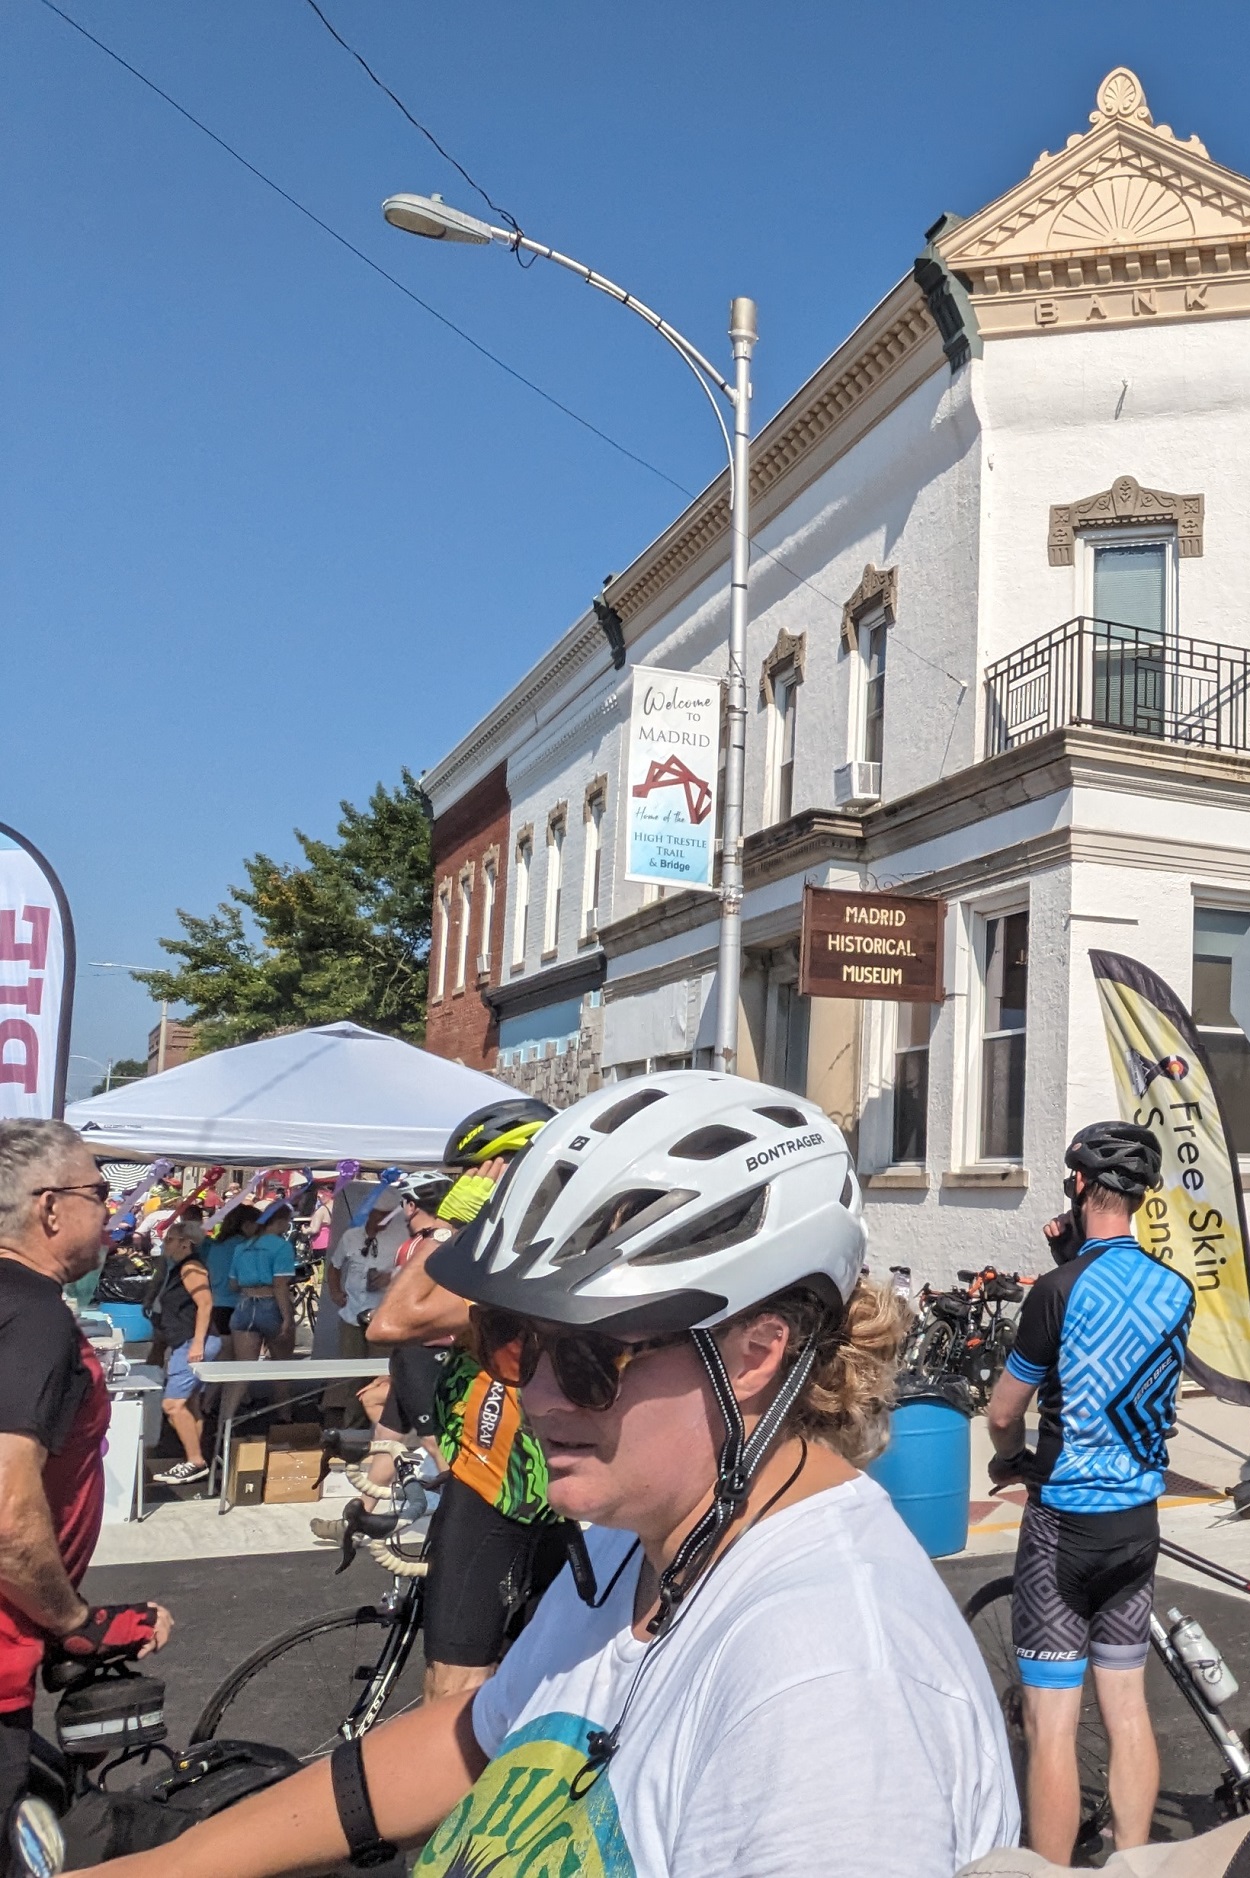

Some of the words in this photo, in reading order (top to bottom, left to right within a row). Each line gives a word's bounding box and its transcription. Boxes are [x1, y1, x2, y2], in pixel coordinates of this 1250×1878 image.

[1035, 284, 1209, 326] BANK
[643, 686, 712, 716] Welcome
[686, 712, 701, 722] TO
[638, 726, 711, 748] MADRID
[635, 806, 659, 820] Home
[663, 810, 672, 823] of
[674, 811, 685, 823] the
[634, 832, 663, 843] HIGH
[667, 834, 707, 849] TRESTLE
[656, 846, 685, 858] TRAIL
[649, 858, 658, 868] &
[660, 859, 691, 873] Bridge
[845, 906, 906, 927] MADRID
[828, 934, 916, 957] HISTORICAL
[842, 964, 903, 985] MUSEUM
[745, 1132, 825, 1173] BONTRAGER
[1169, 1101, 1204, 1192] Free
[1188, 1208, 1227, 1291] Skin
[1153, 1355, 1174, 1380] BIKE
[1038, 1650, 1079, 1660] BIKE
